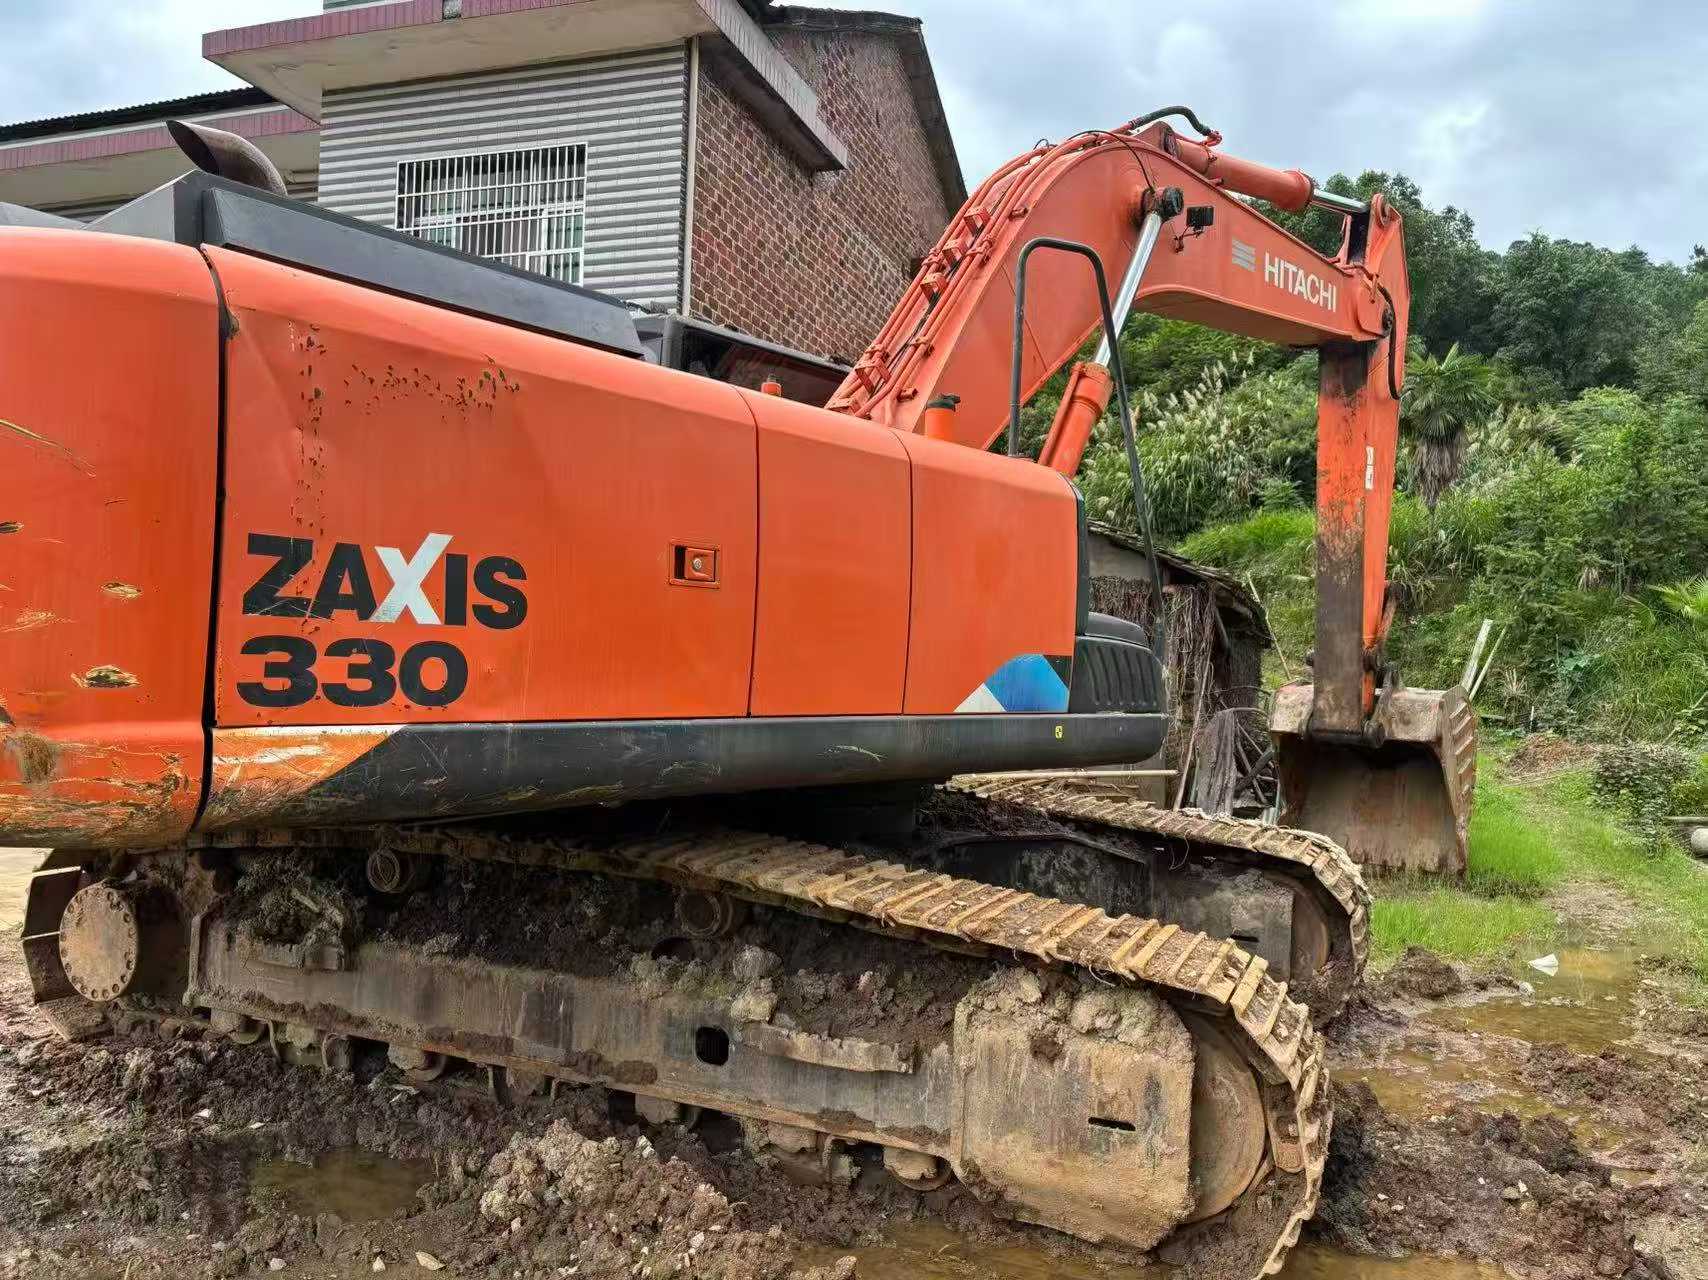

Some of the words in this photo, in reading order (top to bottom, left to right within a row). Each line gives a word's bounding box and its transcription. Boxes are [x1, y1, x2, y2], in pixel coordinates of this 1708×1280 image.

[1264, 251, 1337, 313] HITACHI
[242, 532, 528, 630] ZAXIS
[236, 634, 469, 708] 330
